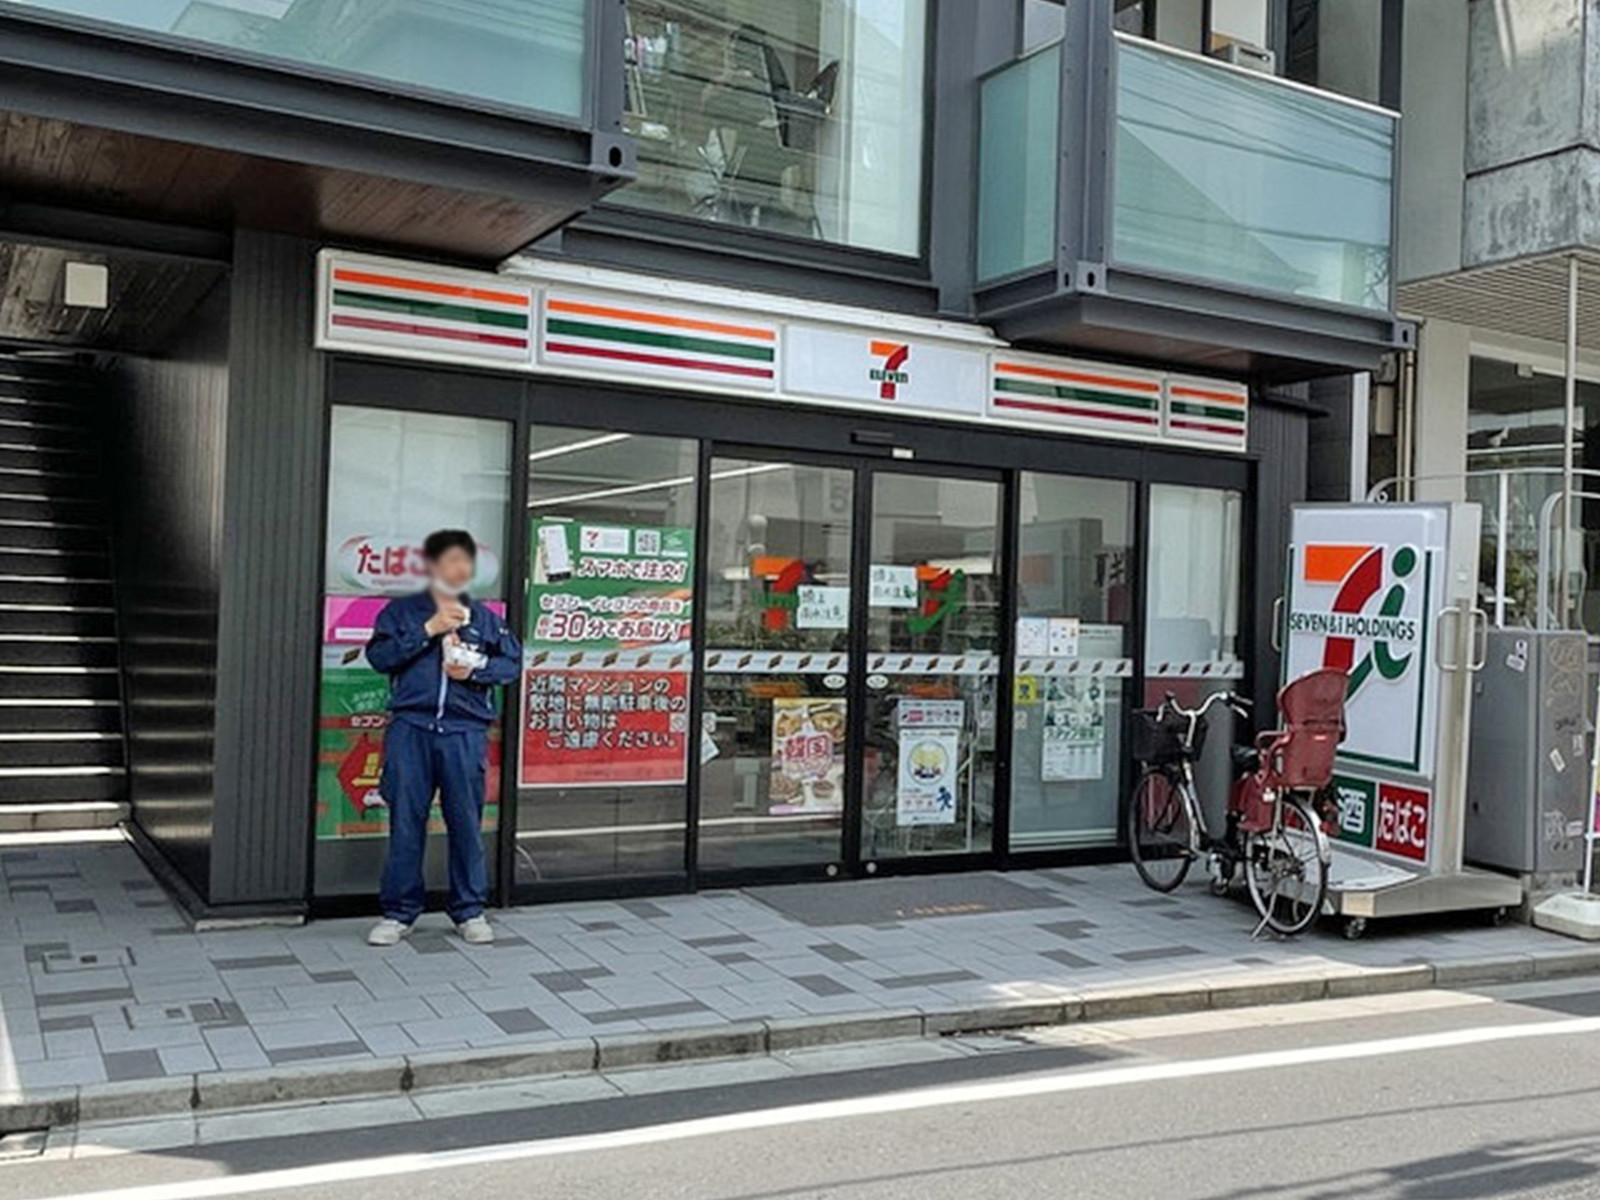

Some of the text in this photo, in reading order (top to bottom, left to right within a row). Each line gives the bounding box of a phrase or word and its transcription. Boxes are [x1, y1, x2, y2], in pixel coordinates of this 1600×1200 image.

[1346, 617, 1415, 640] HOLDINGS
[1337, 786, 1368, 834] 酒
[1379, 796, 1426, 848] たばこ
